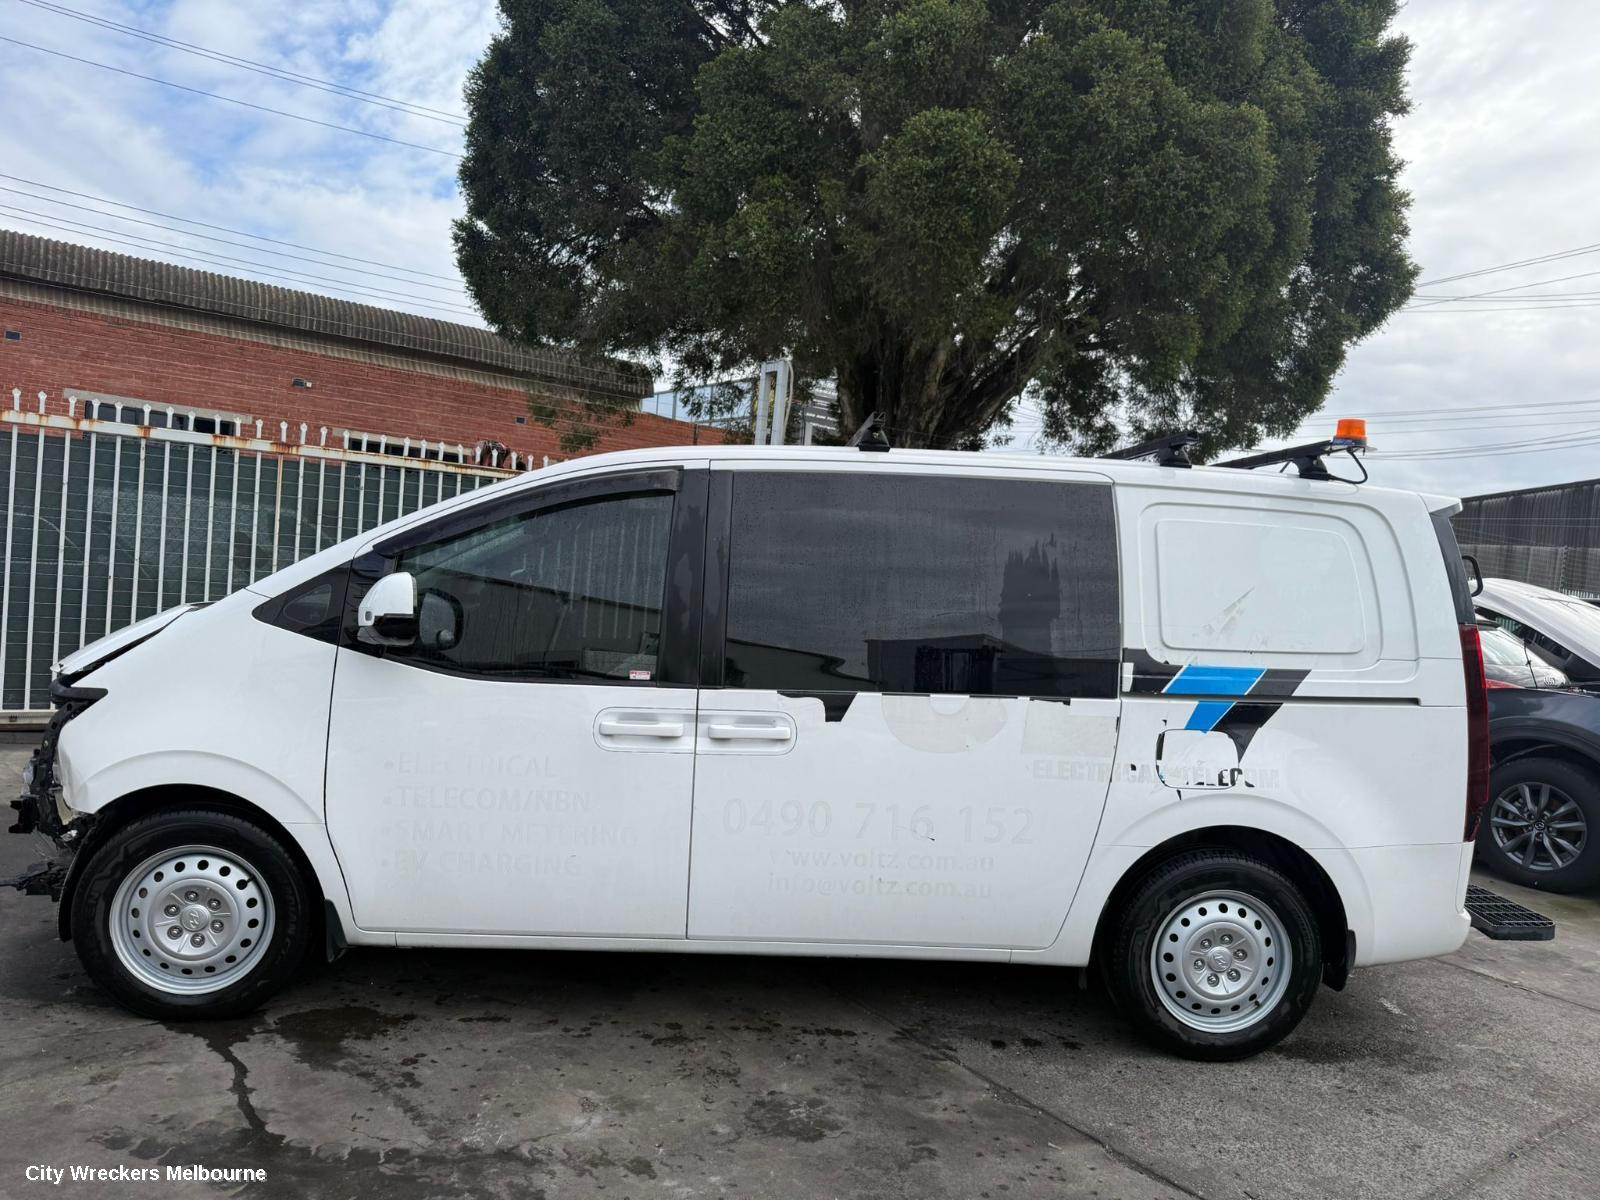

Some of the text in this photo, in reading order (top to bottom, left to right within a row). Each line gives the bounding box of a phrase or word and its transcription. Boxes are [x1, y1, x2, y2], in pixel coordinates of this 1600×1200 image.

[1033, 759, 1161, 785] ELECTRICA
[721, 796, 1034, 845] 0490 716 152
